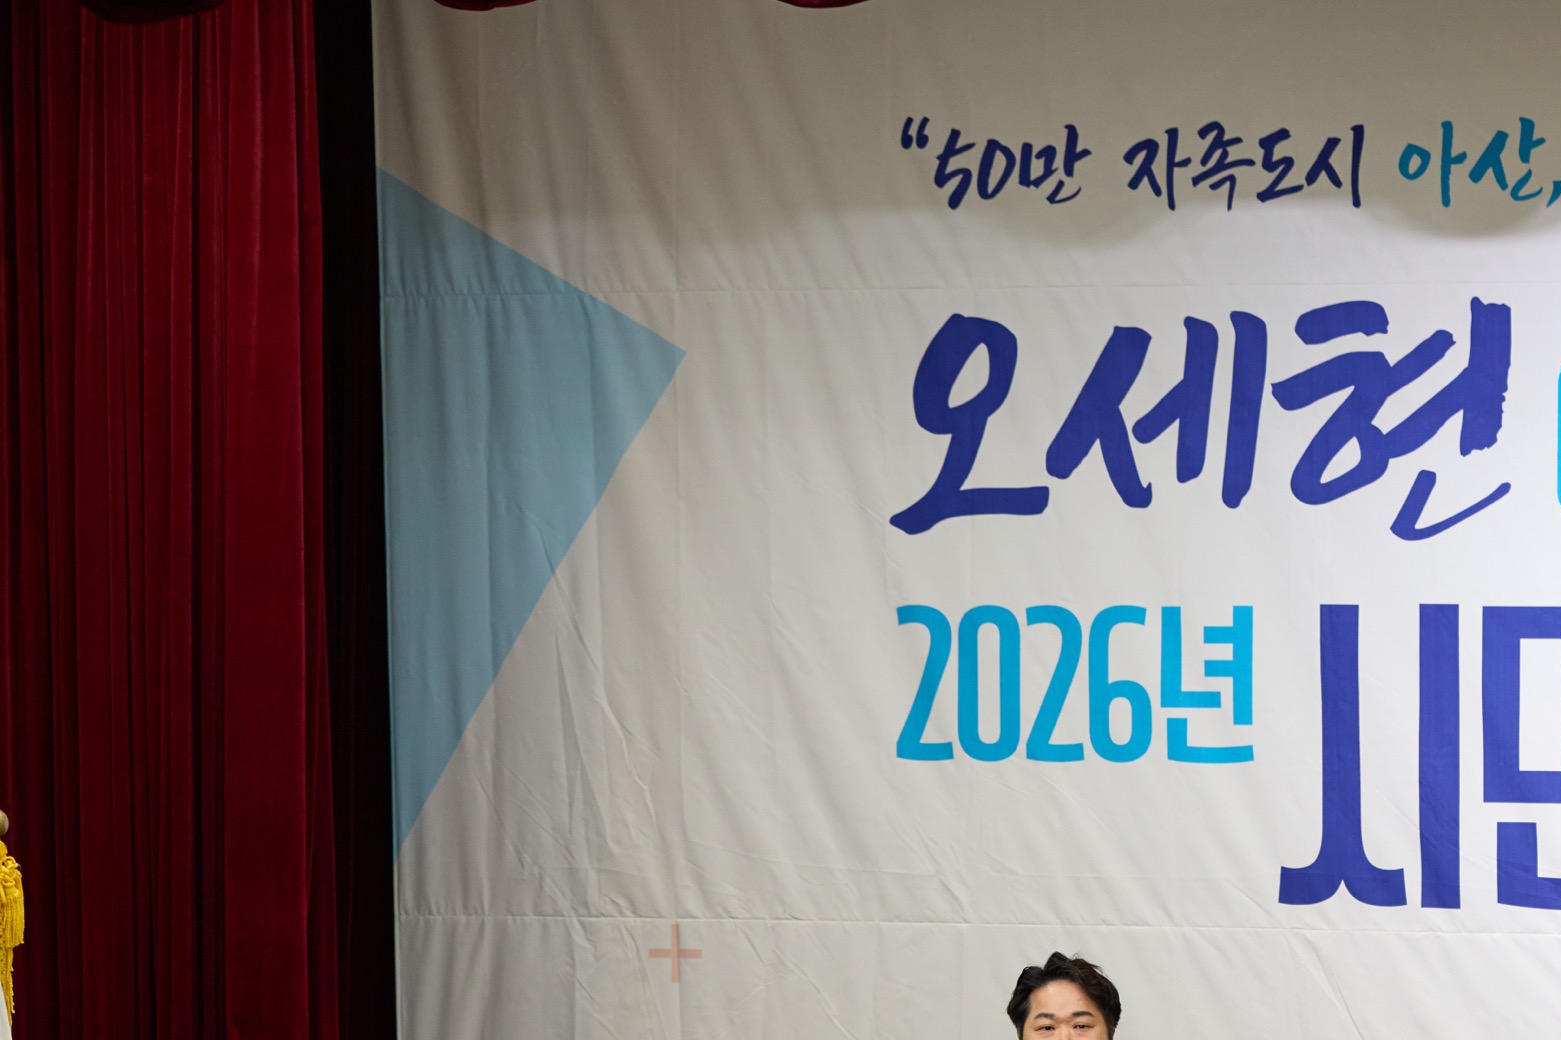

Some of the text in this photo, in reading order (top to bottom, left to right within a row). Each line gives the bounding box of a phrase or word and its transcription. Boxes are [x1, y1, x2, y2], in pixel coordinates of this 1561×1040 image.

[1122, 120, 1365, 211] 자족도시
[889, 296, 1512, 541] 오세현
[895, 604, 1255, 764] 2026년
